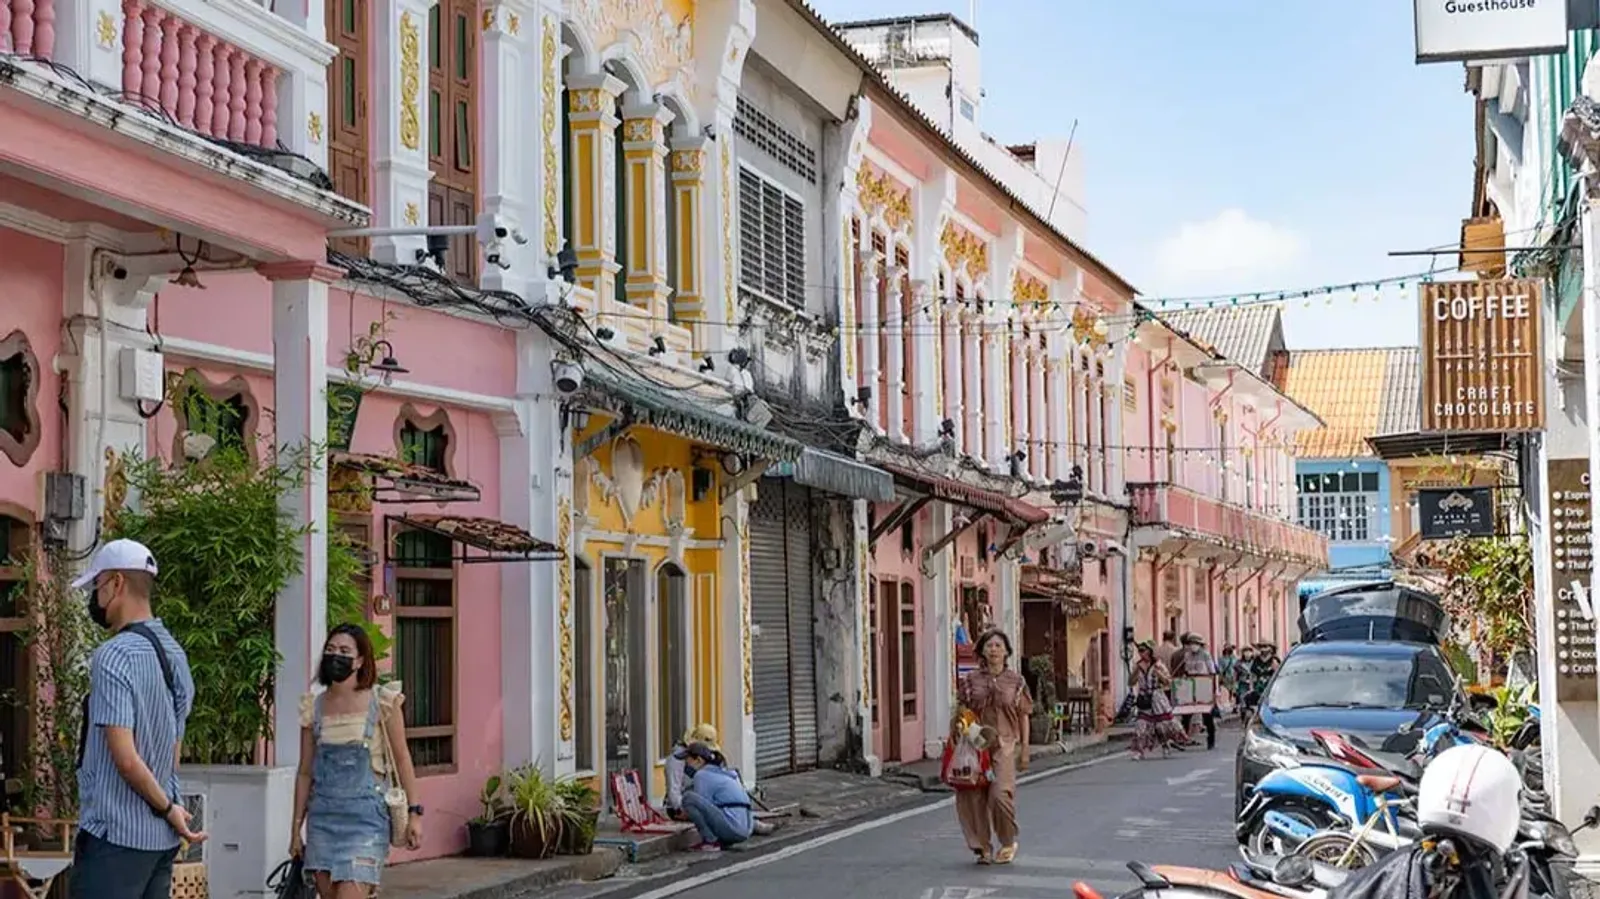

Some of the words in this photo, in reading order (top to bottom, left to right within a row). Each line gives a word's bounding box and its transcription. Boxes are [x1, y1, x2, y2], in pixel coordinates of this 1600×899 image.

[1445, 0, 1536, 13] Guesthouse
[1433, 294, 1531, 321] COFFEE
[1457, 385, 1513, 401] CRAFT
[1434, 401, 1535, 416] CHOCOLATE
